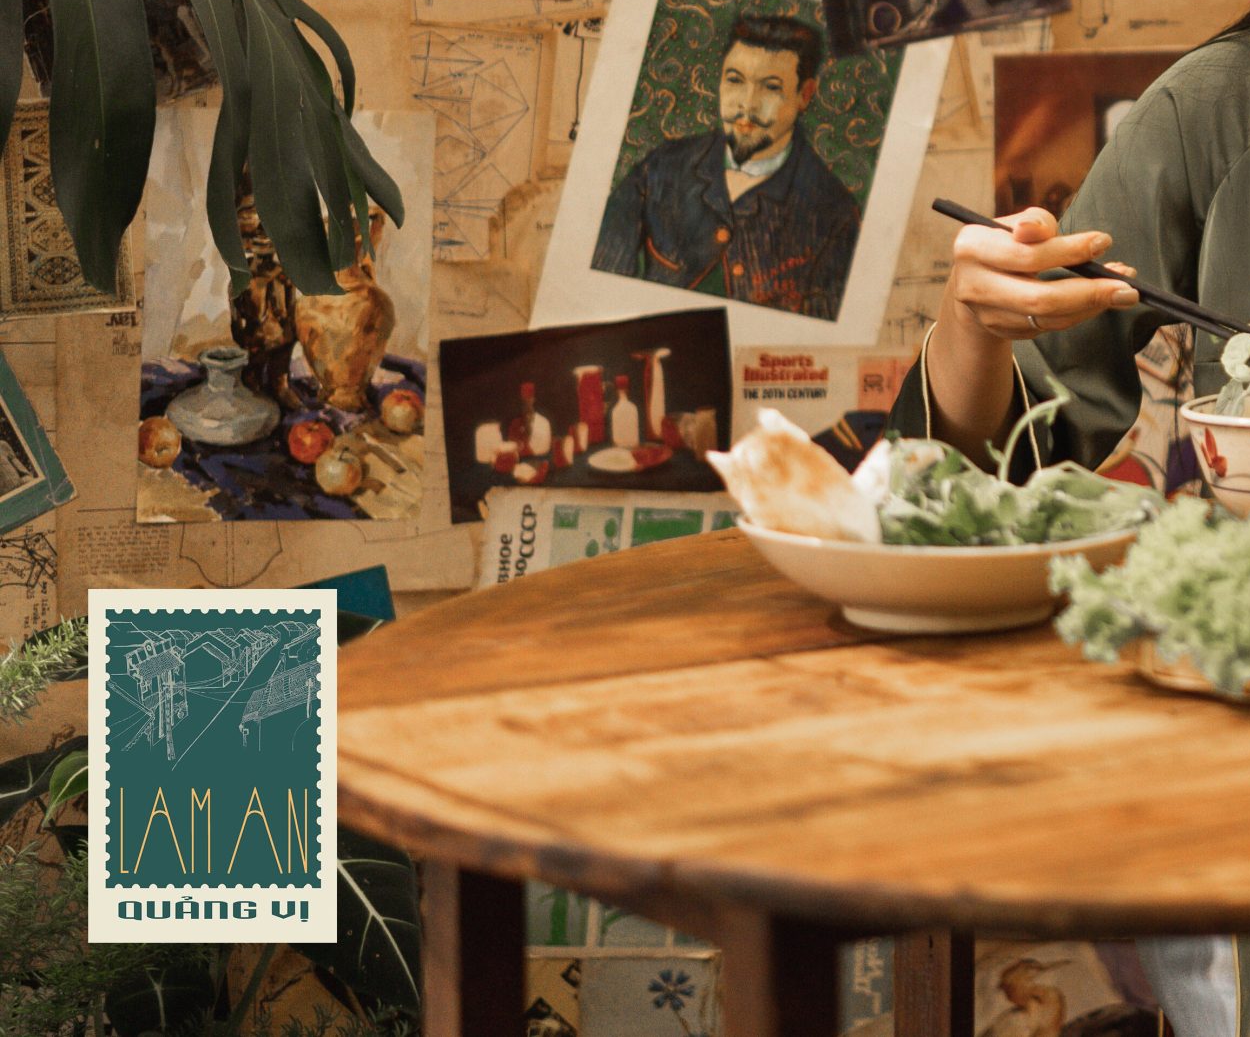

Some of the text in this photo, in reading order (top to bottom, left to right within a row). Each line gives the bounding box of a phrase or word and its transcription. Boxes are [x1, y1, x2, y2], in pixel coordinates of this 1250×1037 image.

[759, 352, 814, 370] Sports
[744, 365, 829, 381] Illustrated
[743, 388, 827, 399] THE 20TH CENTURY
